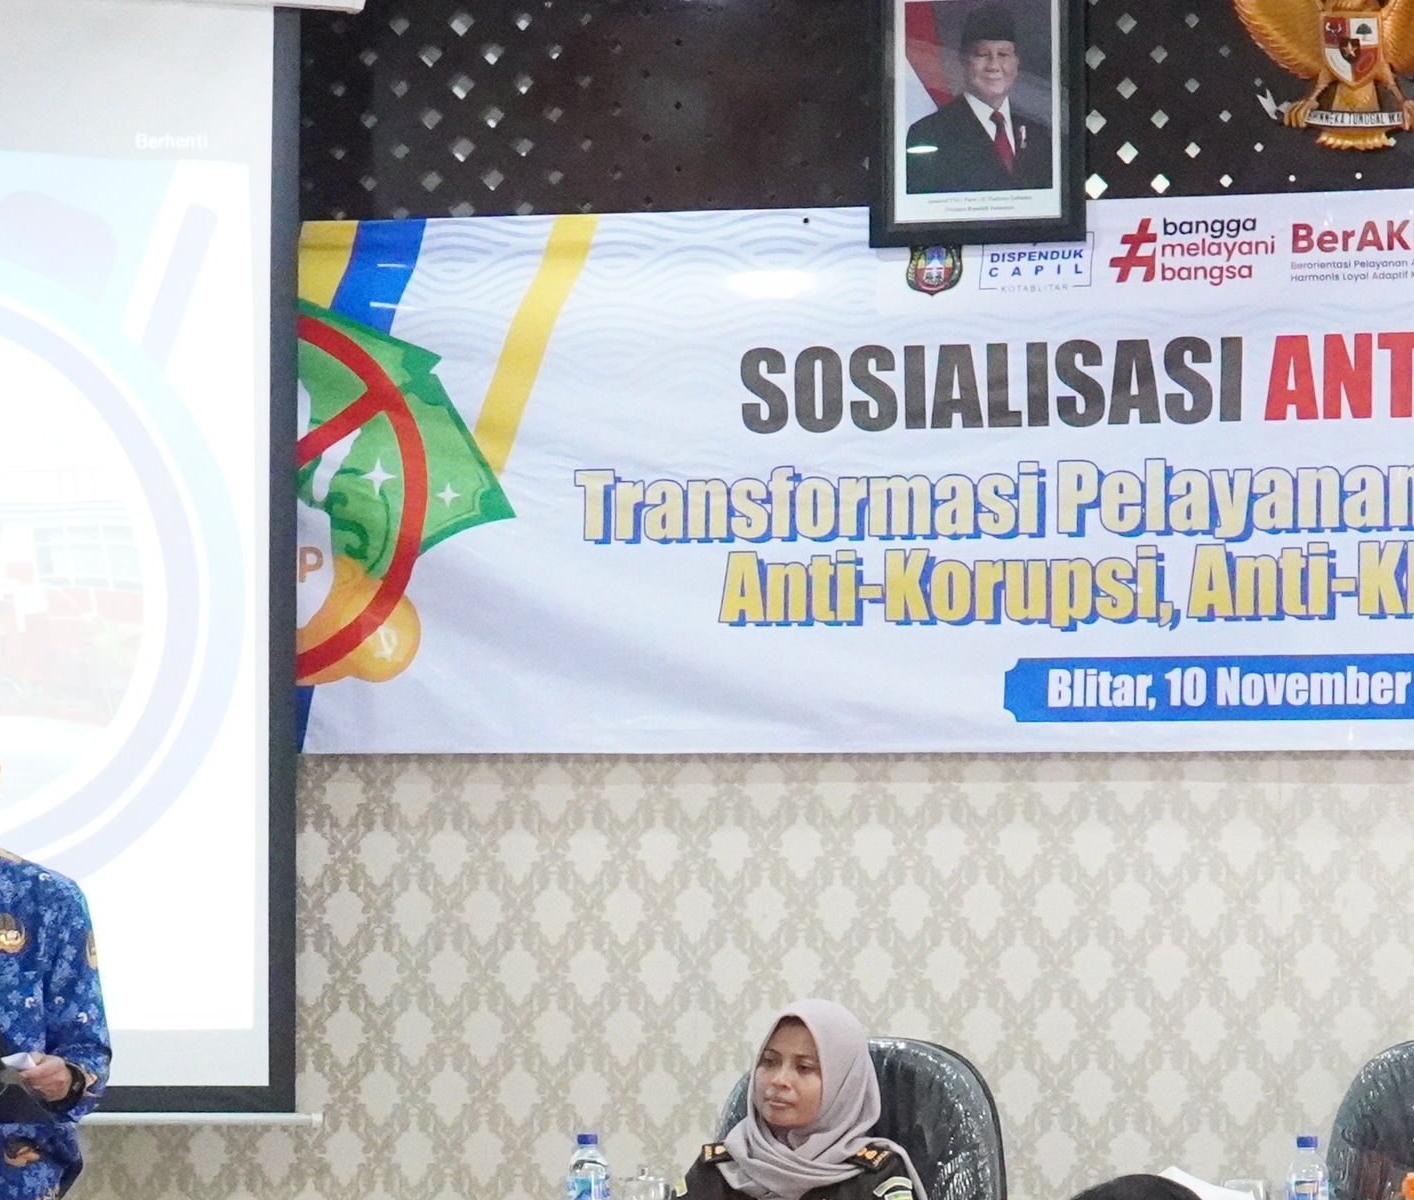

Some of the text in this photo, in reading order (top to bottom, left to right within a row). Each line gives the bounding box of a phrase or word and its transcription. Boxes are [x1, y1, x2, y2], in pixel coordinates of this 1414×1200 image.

[135, 132, 208, 149] Berhenti
[1163, 217, 1257, 239] bangga
[990, 248, 1084, 263] DISPENDUK
[1161, 235, 1276, 262] melayani
[1161, 263, 1253, 286] bangsa
[1290, 259, 1351, 270] Berorientasi
[1354, 258, 1408, 271] Pelayanan
[1290, 272, 1340, 282] Harmonis
[1342, 271, 1369, 283] Loyal
[1372, 270, 1408, 282] Adaptif
[740, 336, 1243, 434] SOSIALISASI
[574, 461, 1046, 543] Transformasi
[718, 545, 1180, 631] Anti-Korupsi,
[1047, 668, 1157, 711] Blitar,
[1164, 668, 1206, 707] 10
[1216, 666, 1412, 707] November
